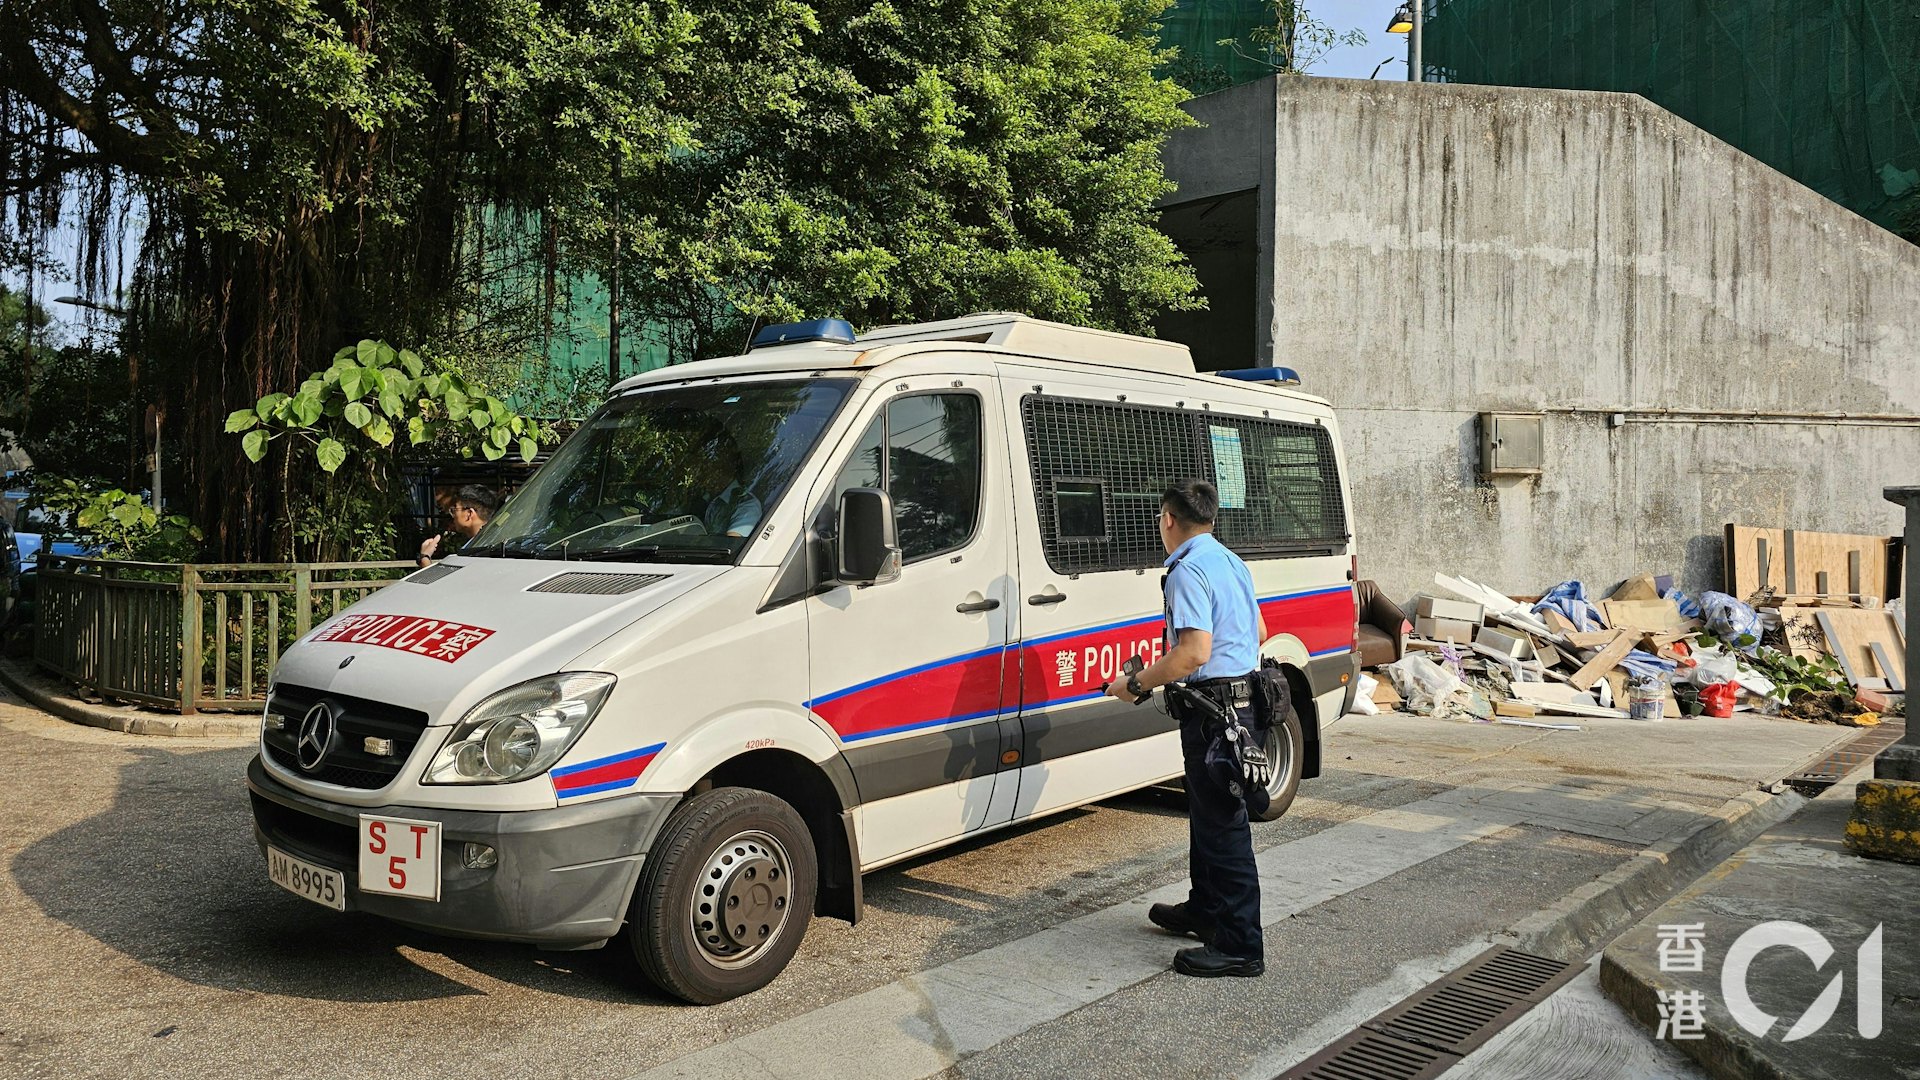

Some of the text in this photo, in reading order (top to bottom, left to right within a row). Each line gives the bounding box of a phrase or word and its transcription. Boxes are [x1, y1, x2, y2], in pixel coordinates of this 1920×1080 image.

[332, 615, 462, 653] POLICE
[429, 628, 488, 660] 察
[1055, 649, 1077, 687] 警
[745, 738, 775, 749] 420kPa
[369, 821, 428, 859] S T
[272, 854, 336, 903] AM 8995
[388, 856, 407, 890] 5
